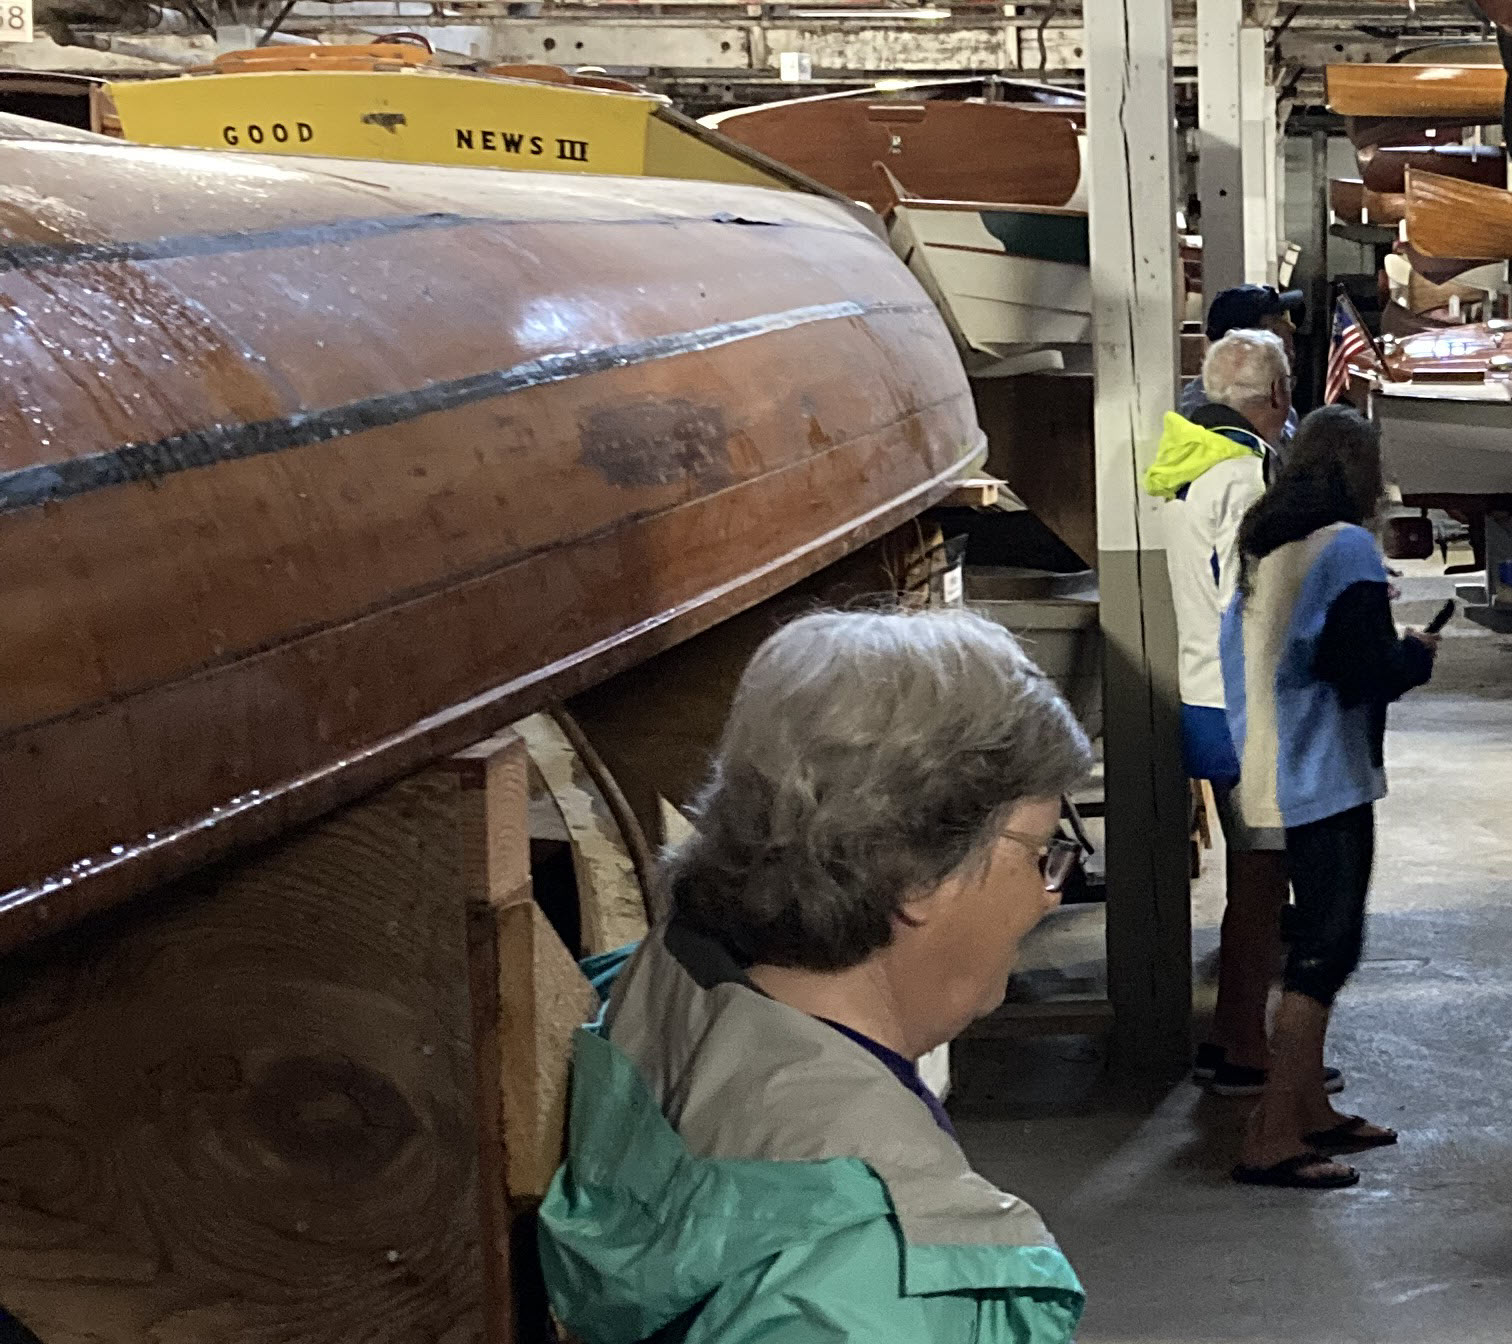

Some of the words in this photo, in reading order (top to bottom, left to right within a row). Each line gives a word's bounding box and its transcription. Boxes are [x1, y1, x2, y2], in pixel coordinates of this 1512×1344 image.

[0, 5, 25, 30] 8
[223, 122, 314, 146] GOOD
[456, 128, 544, 155] NEWS
[556, 138, 589, 162] III
